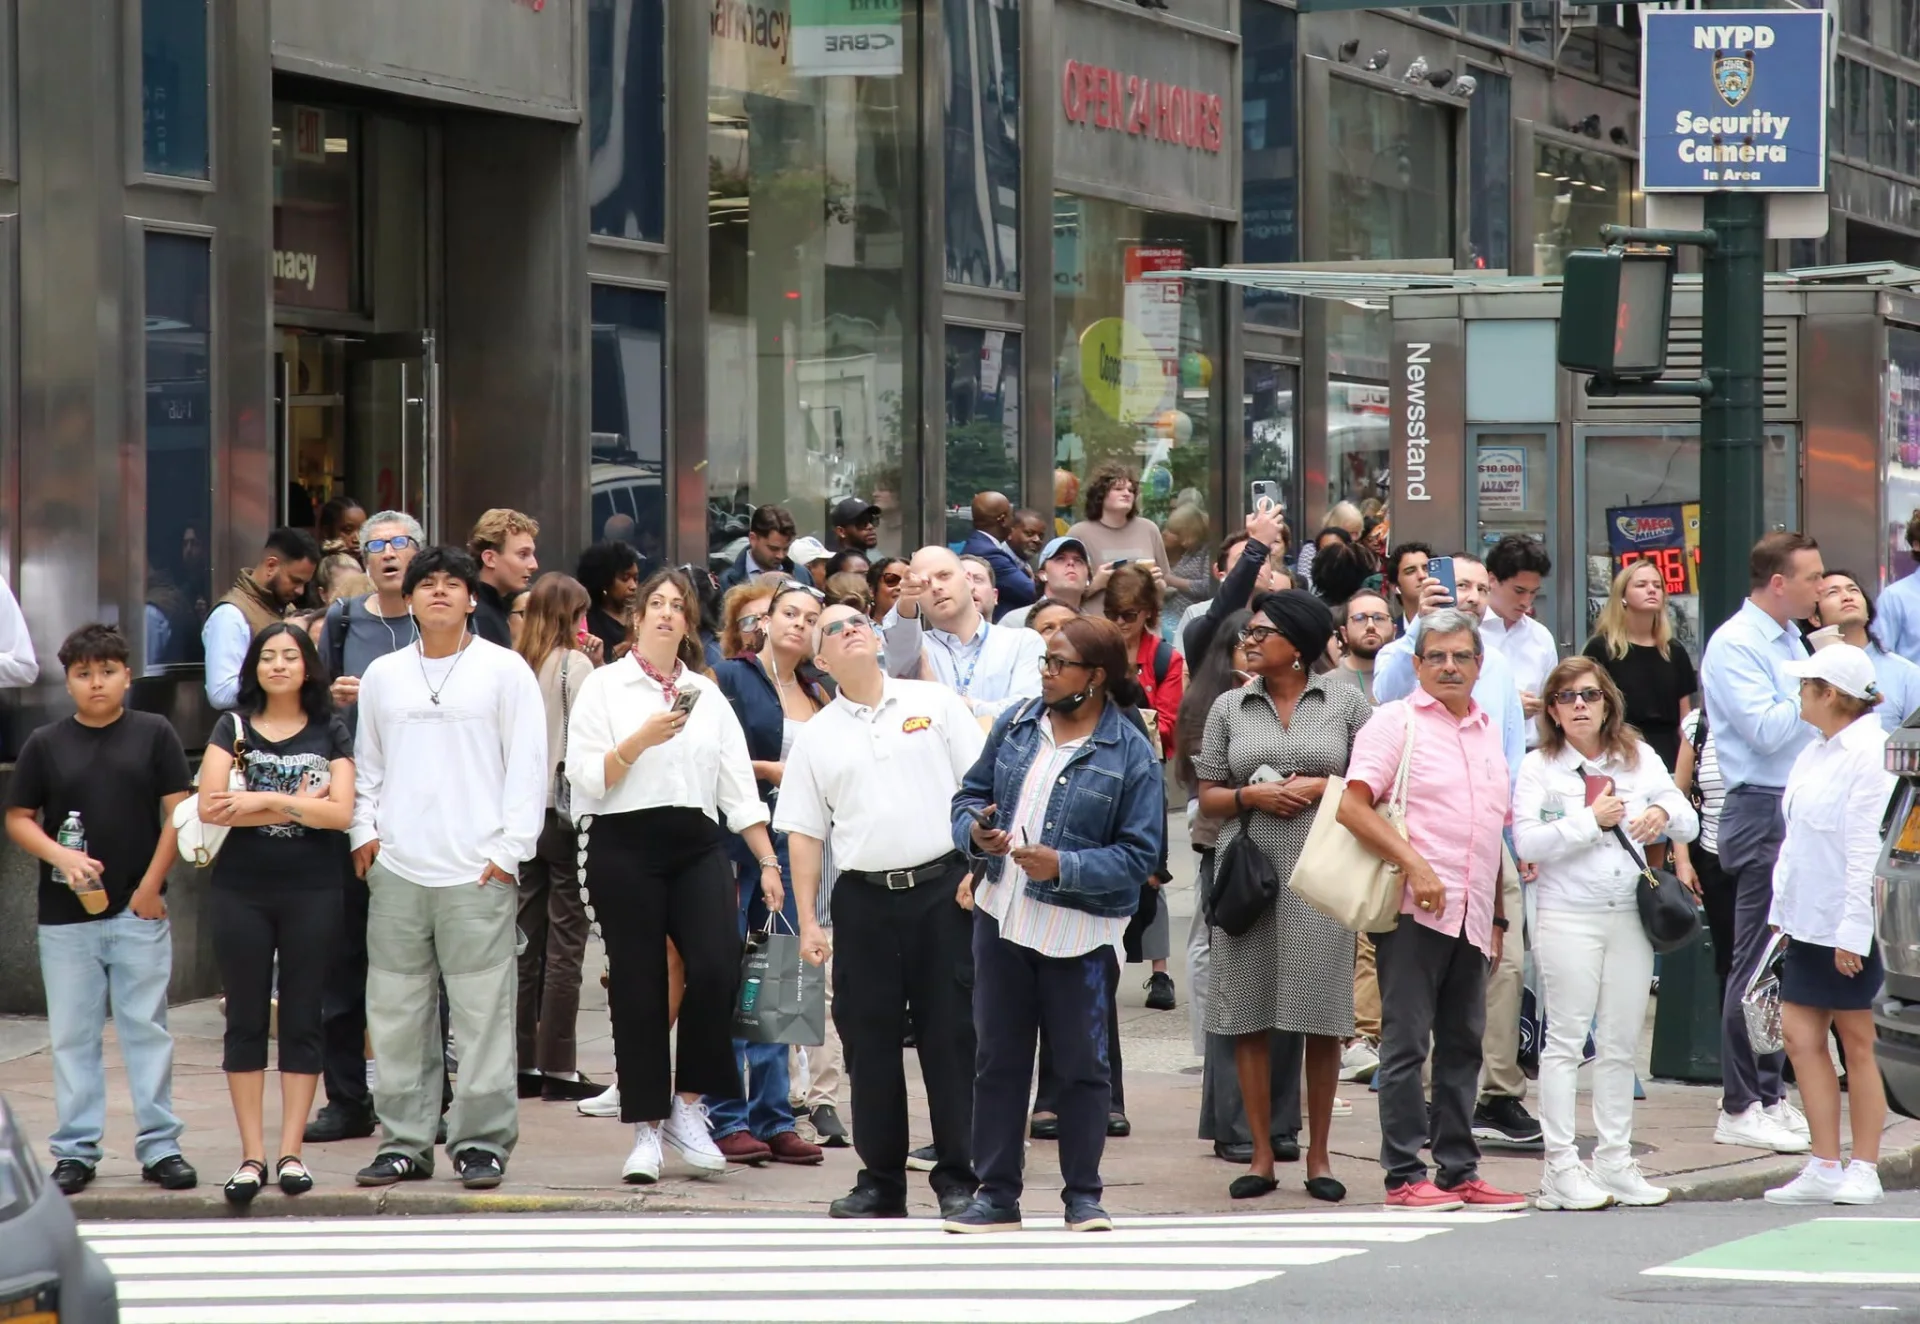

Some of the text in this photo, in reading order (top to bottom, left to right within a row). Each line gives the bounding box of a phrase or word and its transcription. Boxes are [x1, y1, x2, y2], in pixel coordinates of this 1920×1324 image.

[1694, 26, 1775, 49] NYPD
[1065, 59, 1223, 154] OPEN 24 HOURS
[1675, 109, 1790, 139] Security
[1678, 139, 1787, 163] Camera
[1703, 169, 1761, 180] In Area
[1406, 342, 1431, 501] Newsstand
[1636, 517, 1674, 533] MEGA
